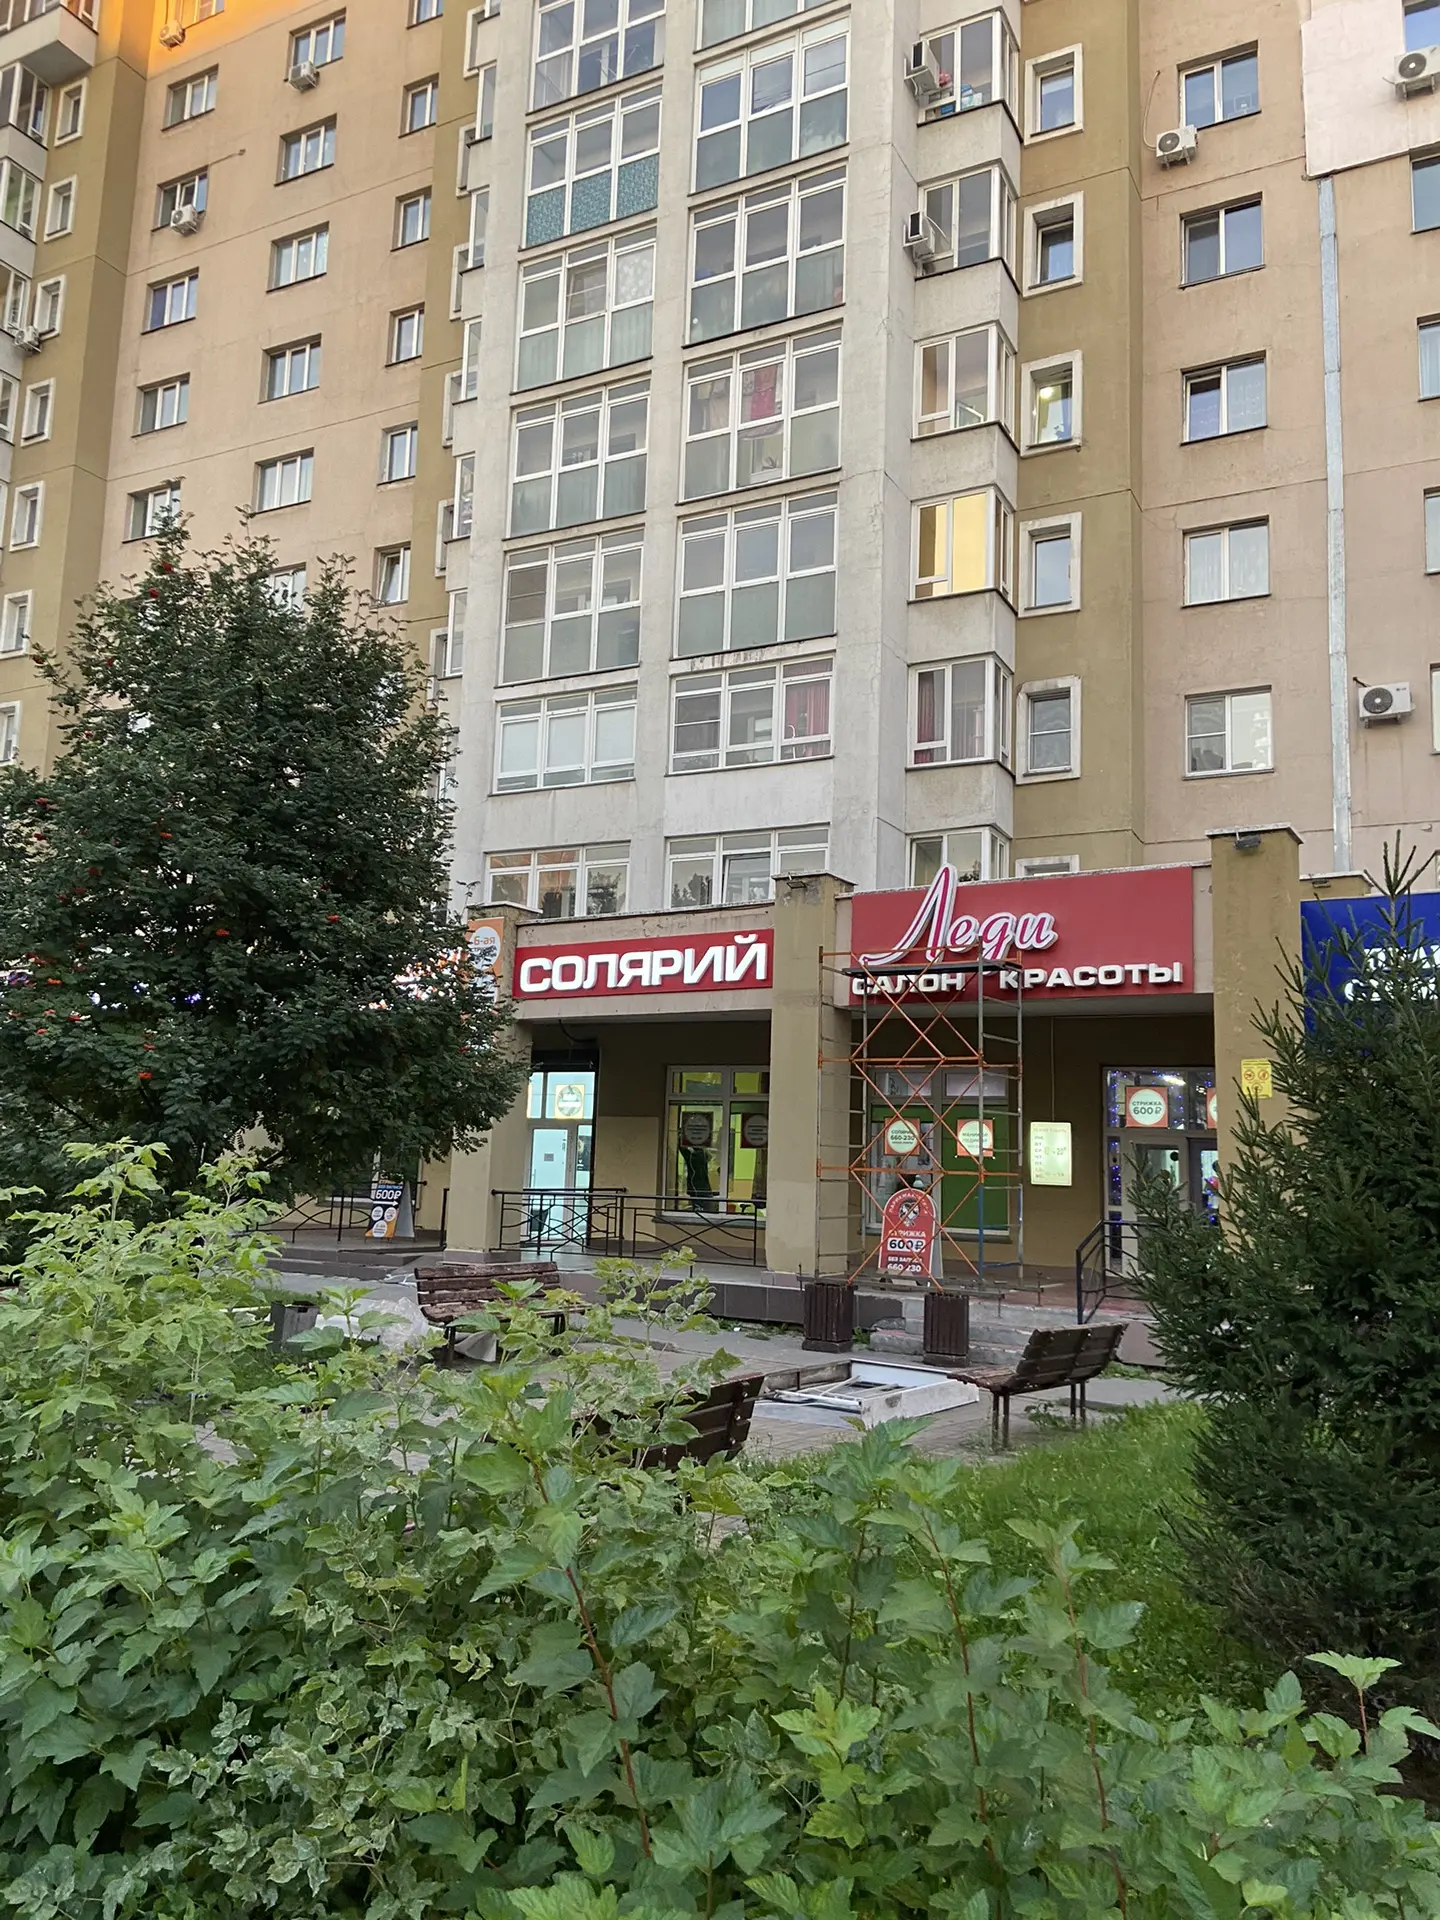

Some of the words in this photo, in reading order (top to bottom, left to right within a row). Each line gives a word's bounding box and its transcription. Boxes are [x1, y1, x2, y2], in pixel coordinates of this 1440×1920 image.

[858, 862, 1058, 974] Леди
[520, 933, 768, 993] СОЛЯРИЙ
[852, 973, 966, 996] САЛОН
[1000, 962, 1183, 990] КРАСОТЫ
